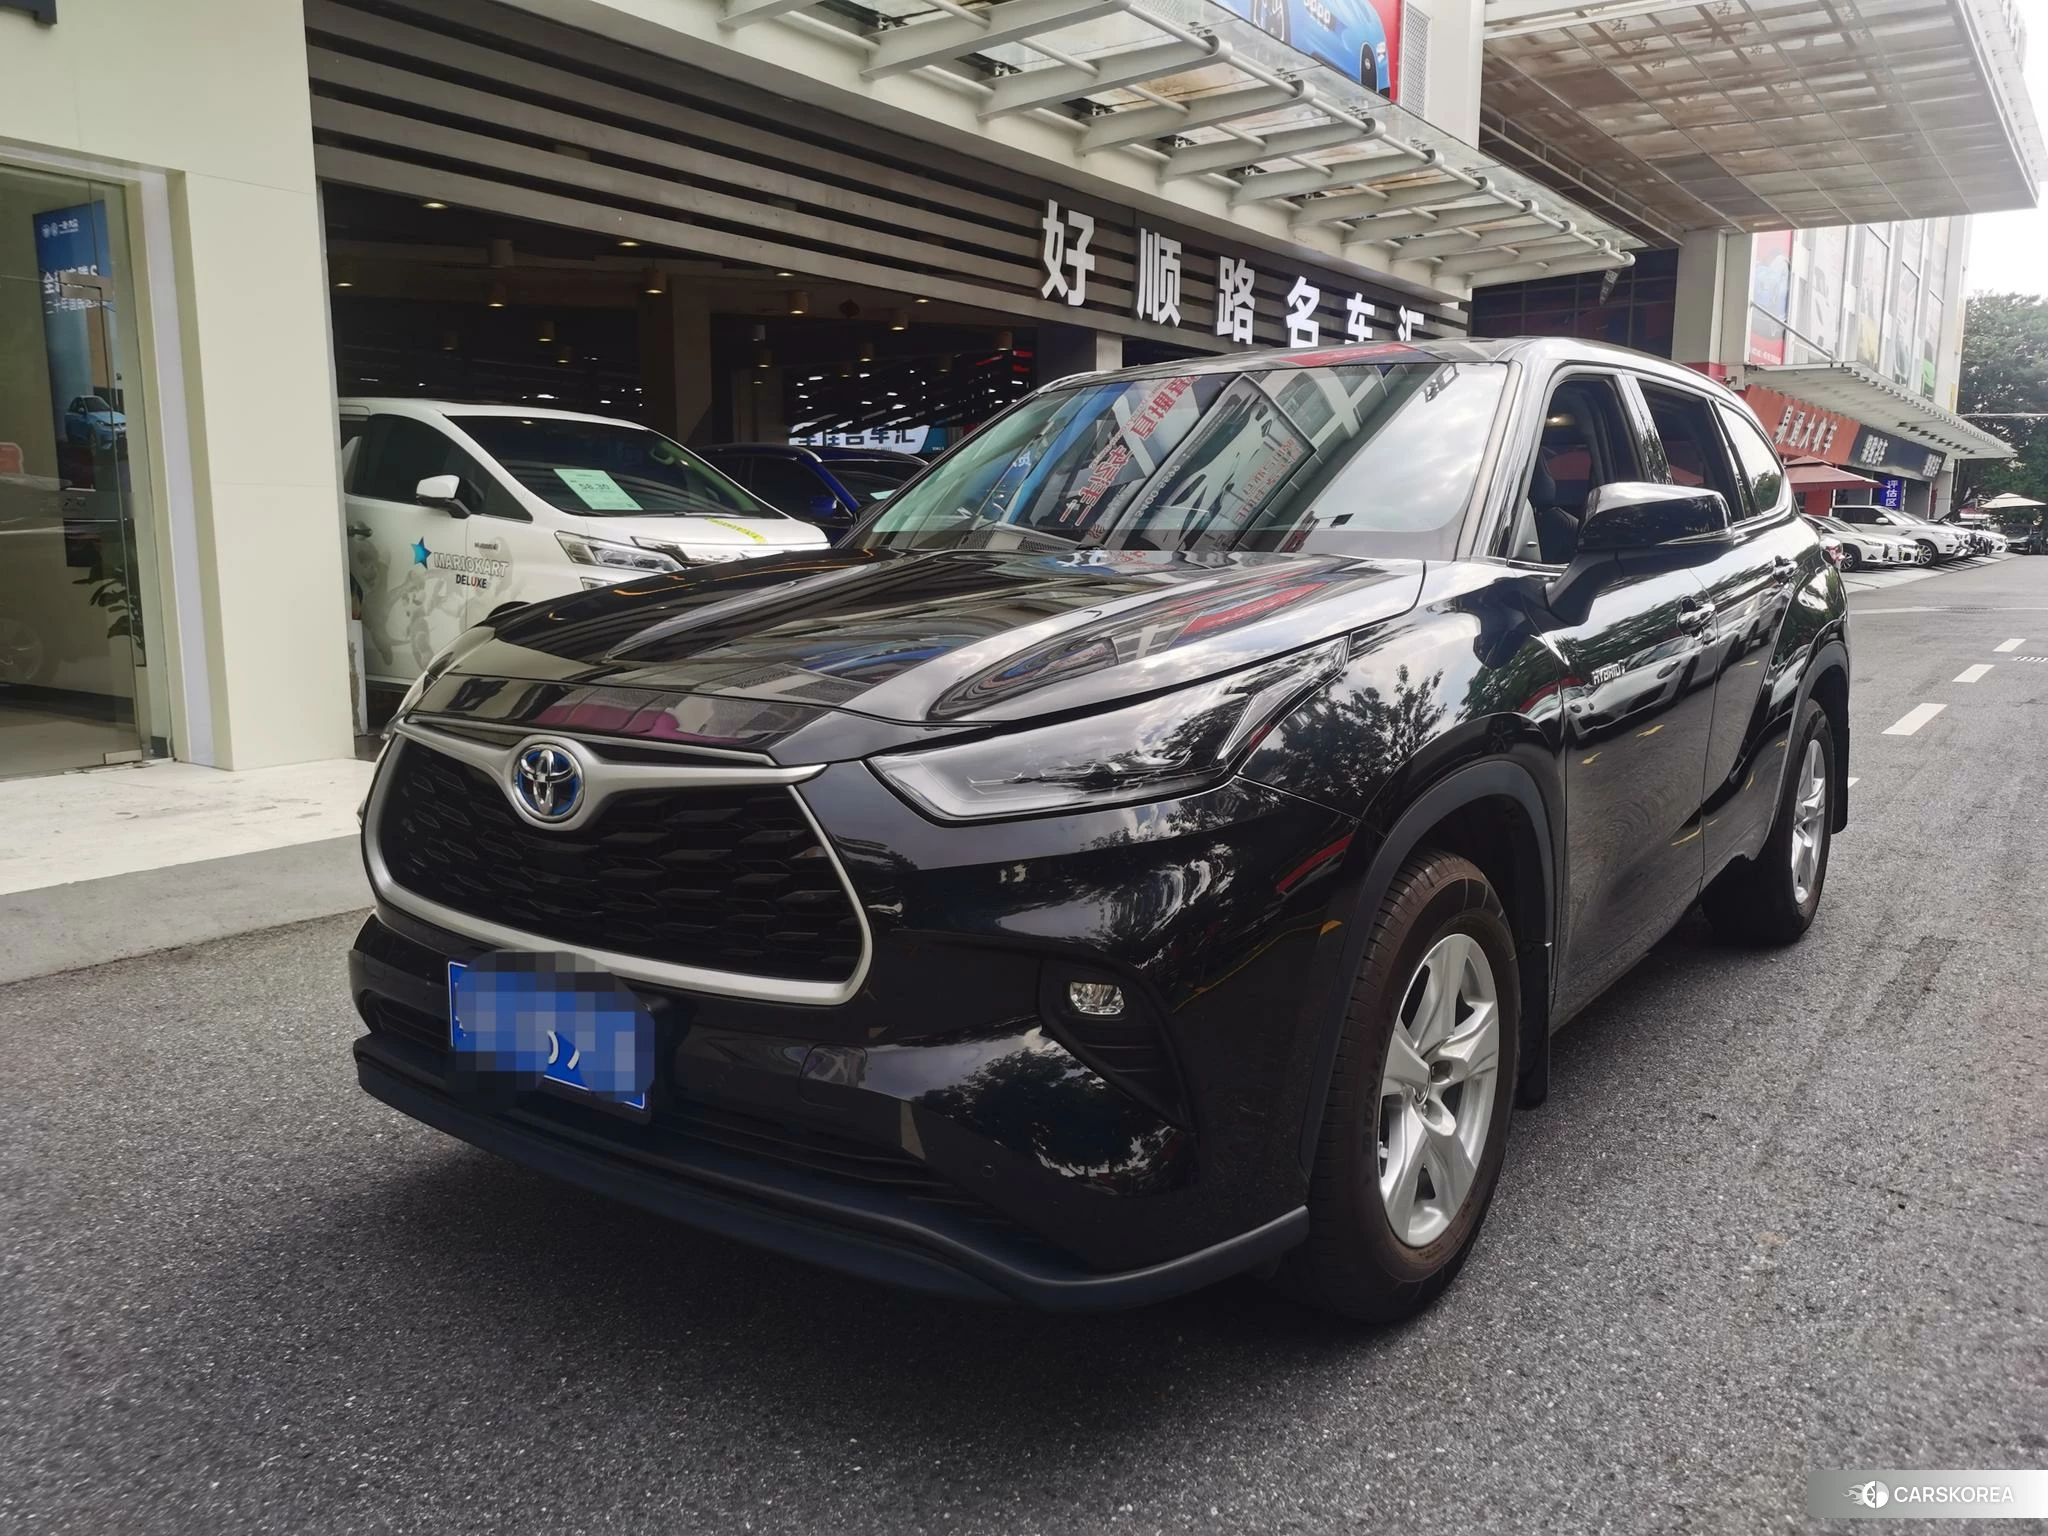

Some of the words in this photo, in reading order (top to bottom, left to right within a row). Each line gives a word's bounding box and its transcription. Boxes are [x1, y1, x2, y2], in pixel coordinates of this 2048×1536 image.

[1041, 199, 1425, 352] 好顺路名车汇
[1885, 480, 1899, 507] 评估区
[455, 574, 487, 589] DELUXE
